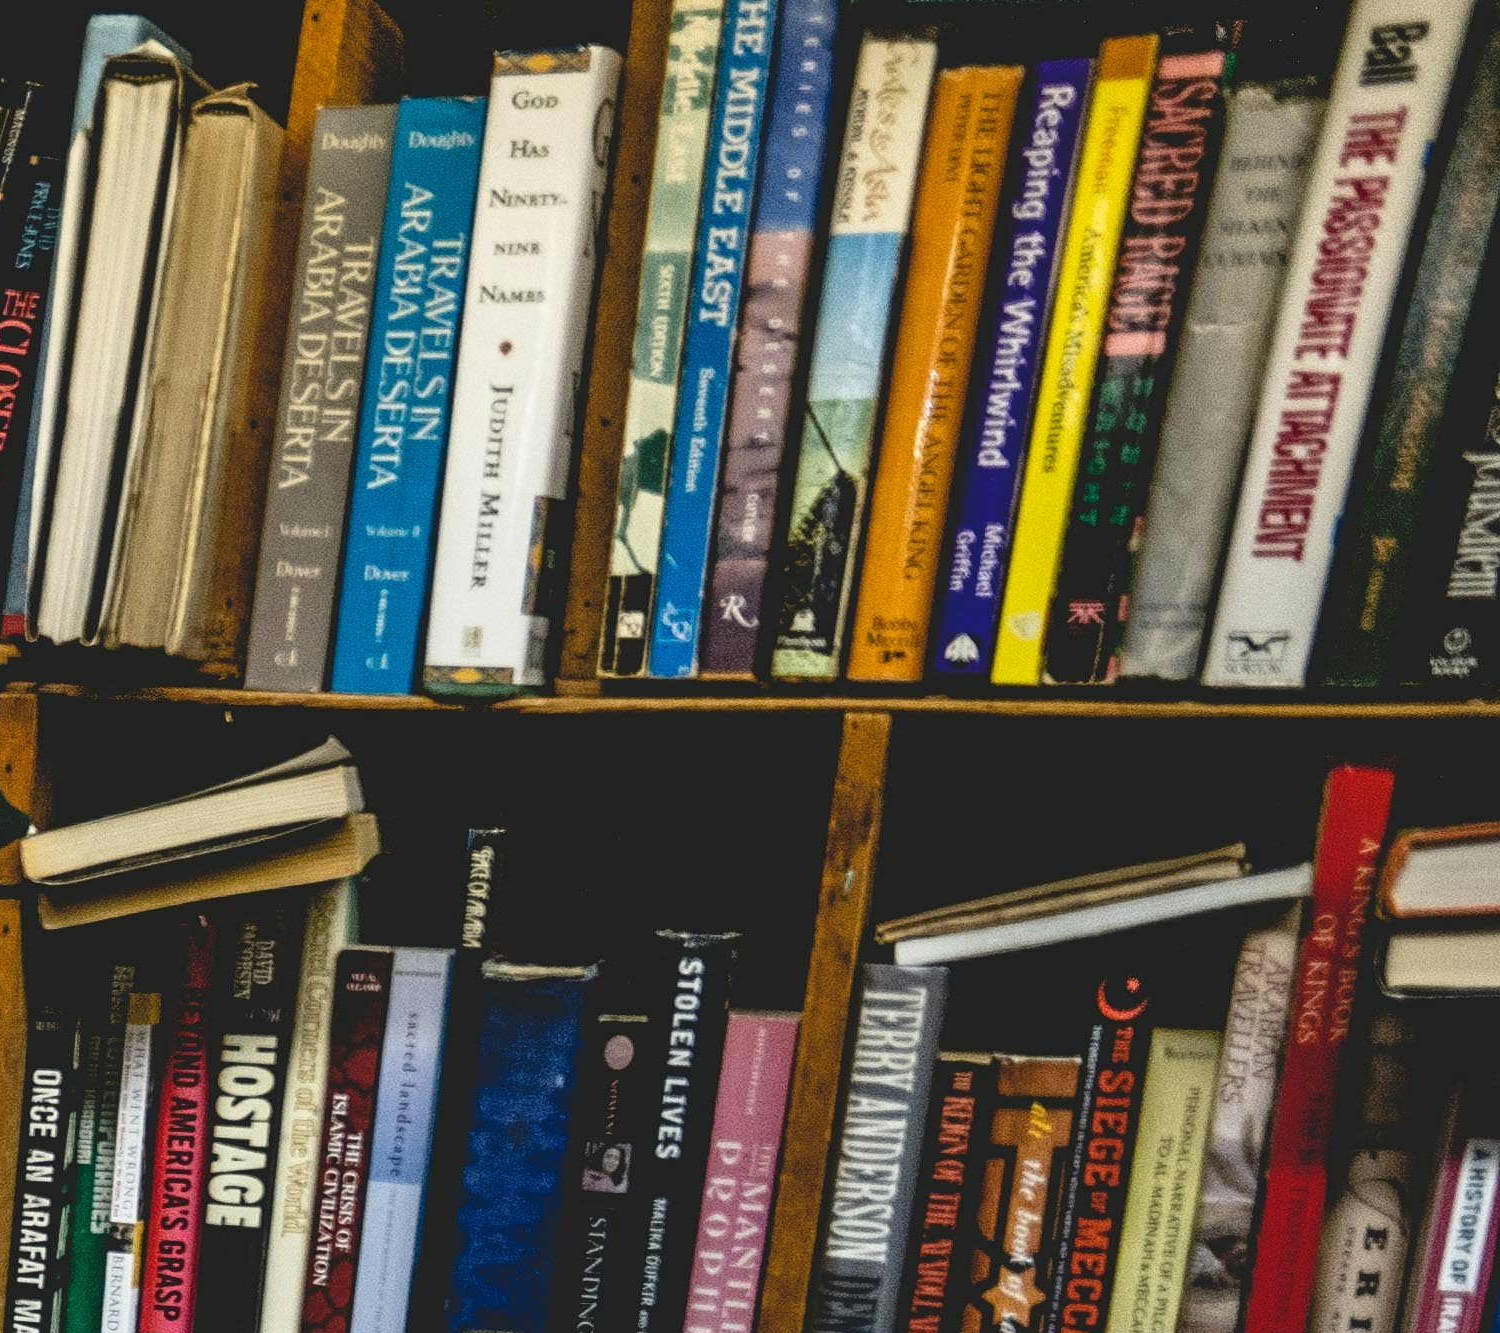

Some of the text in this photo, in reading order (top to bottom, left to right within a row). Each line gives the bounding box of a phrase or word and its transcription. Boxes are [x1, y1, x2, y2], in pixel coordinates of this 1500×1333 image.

[367, 182, 434, 489] ARABIA DESERTA
[409, 234, 467, 441] TRAVELS IN
[979, 84, 1076, 468] Reaping the Whirlwind
[1254, 107, 1408, 561] THE PASSIONATE ATTACHMENT
[29, 1069, 62, 1137] ONCE
[207, 1036, 276, 1228] HOSTAGE
[656, 958, 705, 1159] STOLEN LIVES
[827, 987, 928, 1265] TERRY ANDERSON
[1084, 1070, 1133, 1186] SIEGE
[16, 1194, 51, 1289] ARAFAT
[26, 1150, 54, 1183] AN
